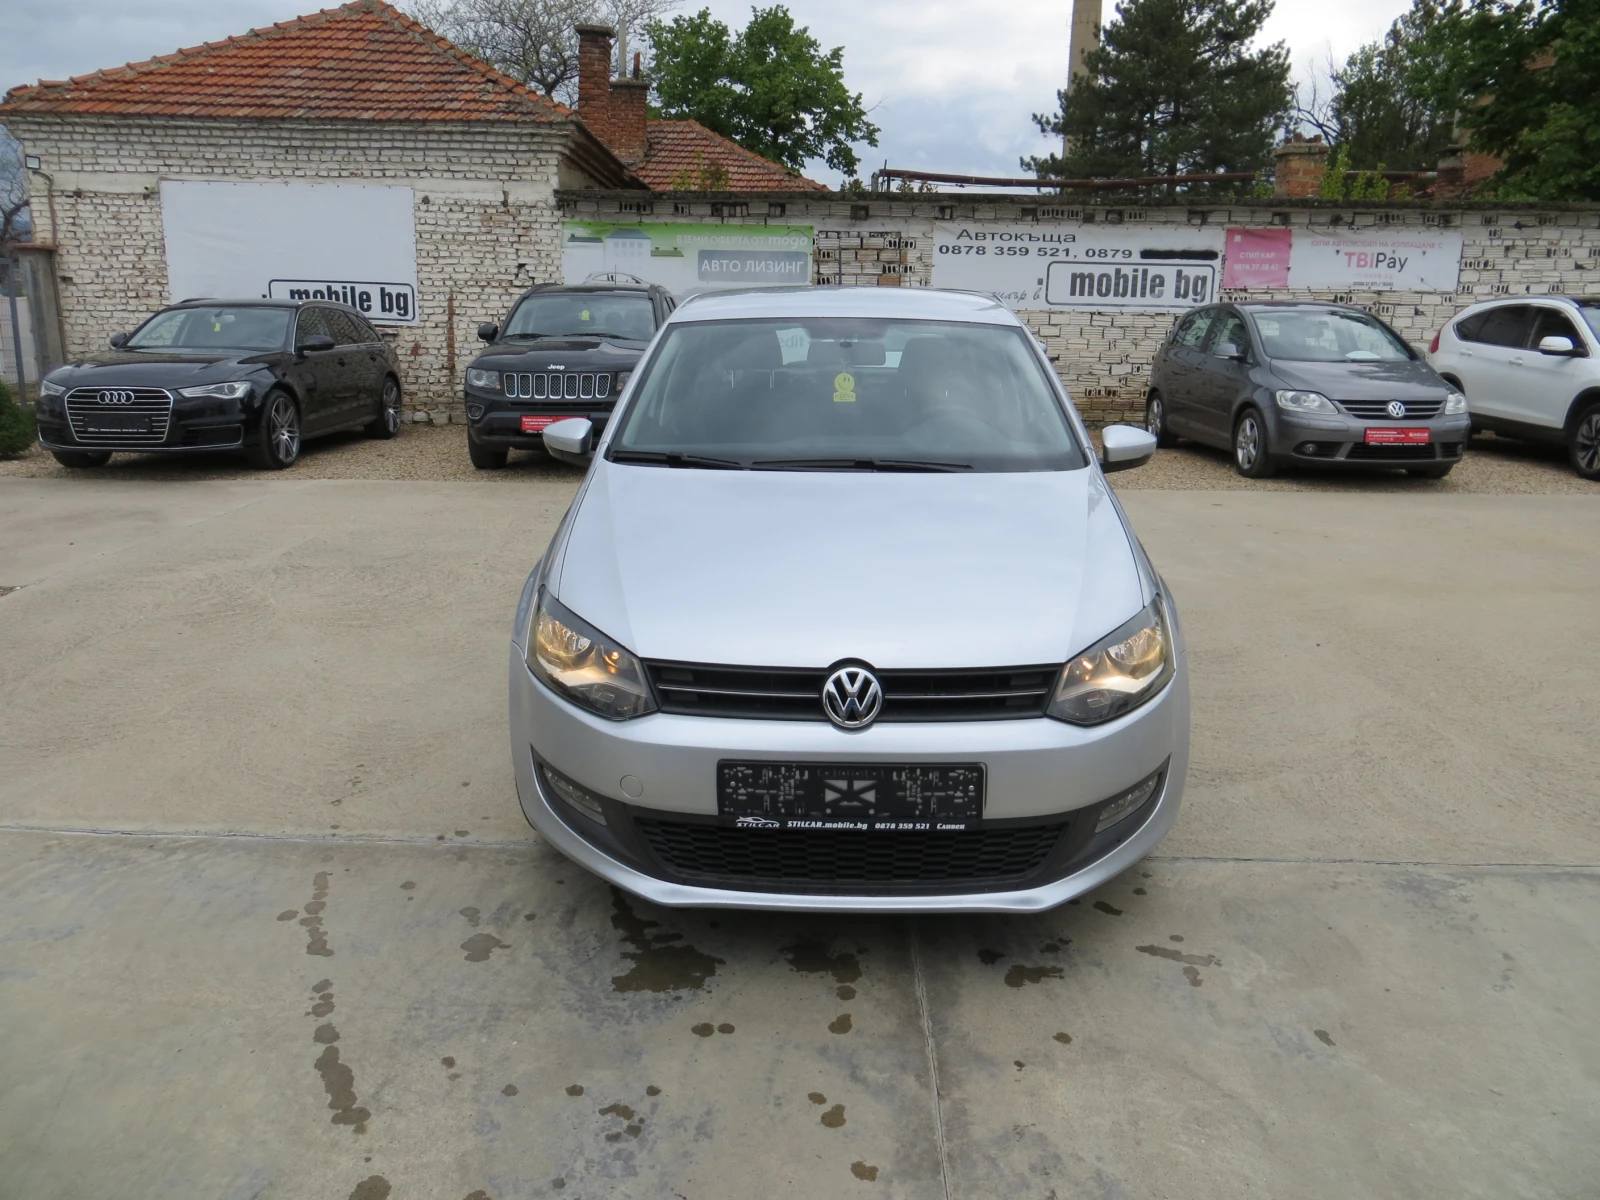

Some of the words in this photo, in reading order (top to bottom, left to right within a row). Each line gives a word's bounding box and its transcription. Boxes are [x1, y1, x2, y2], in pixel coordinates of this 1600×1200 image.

[676, 234, 708, 245] ВЗЕМИ
[709, 235, 750, 246] ОФЕРТА
[751, 236, 767, 246] ОТ
[767, 235, 809, 250] mogo
[956, 228, 1076, 244] Автокъща
[938, 243, 988, 256] 0878
[993, 245, 1030, 257] 359
[1036, 246, 1079, 260] 521,
[1085, 248, 1134, 260] 0879
[700, 259, 742, 273] АВТО
[744, 260, 804, 274] ЛИЗИНГ
[1343, 251, 1409, 273] TBIPay
[1070, 267, 1166, 299] mobile
[1174, 269, 1208, 303] bg
[379, 286, 409, 317] bg
[786, 820, 868, 830] STILCAR.mobile.bg
[874, 822, 897, 830] 0878
[897, 822, 914, 830] 359
[914, 822, 930, 830] 521
